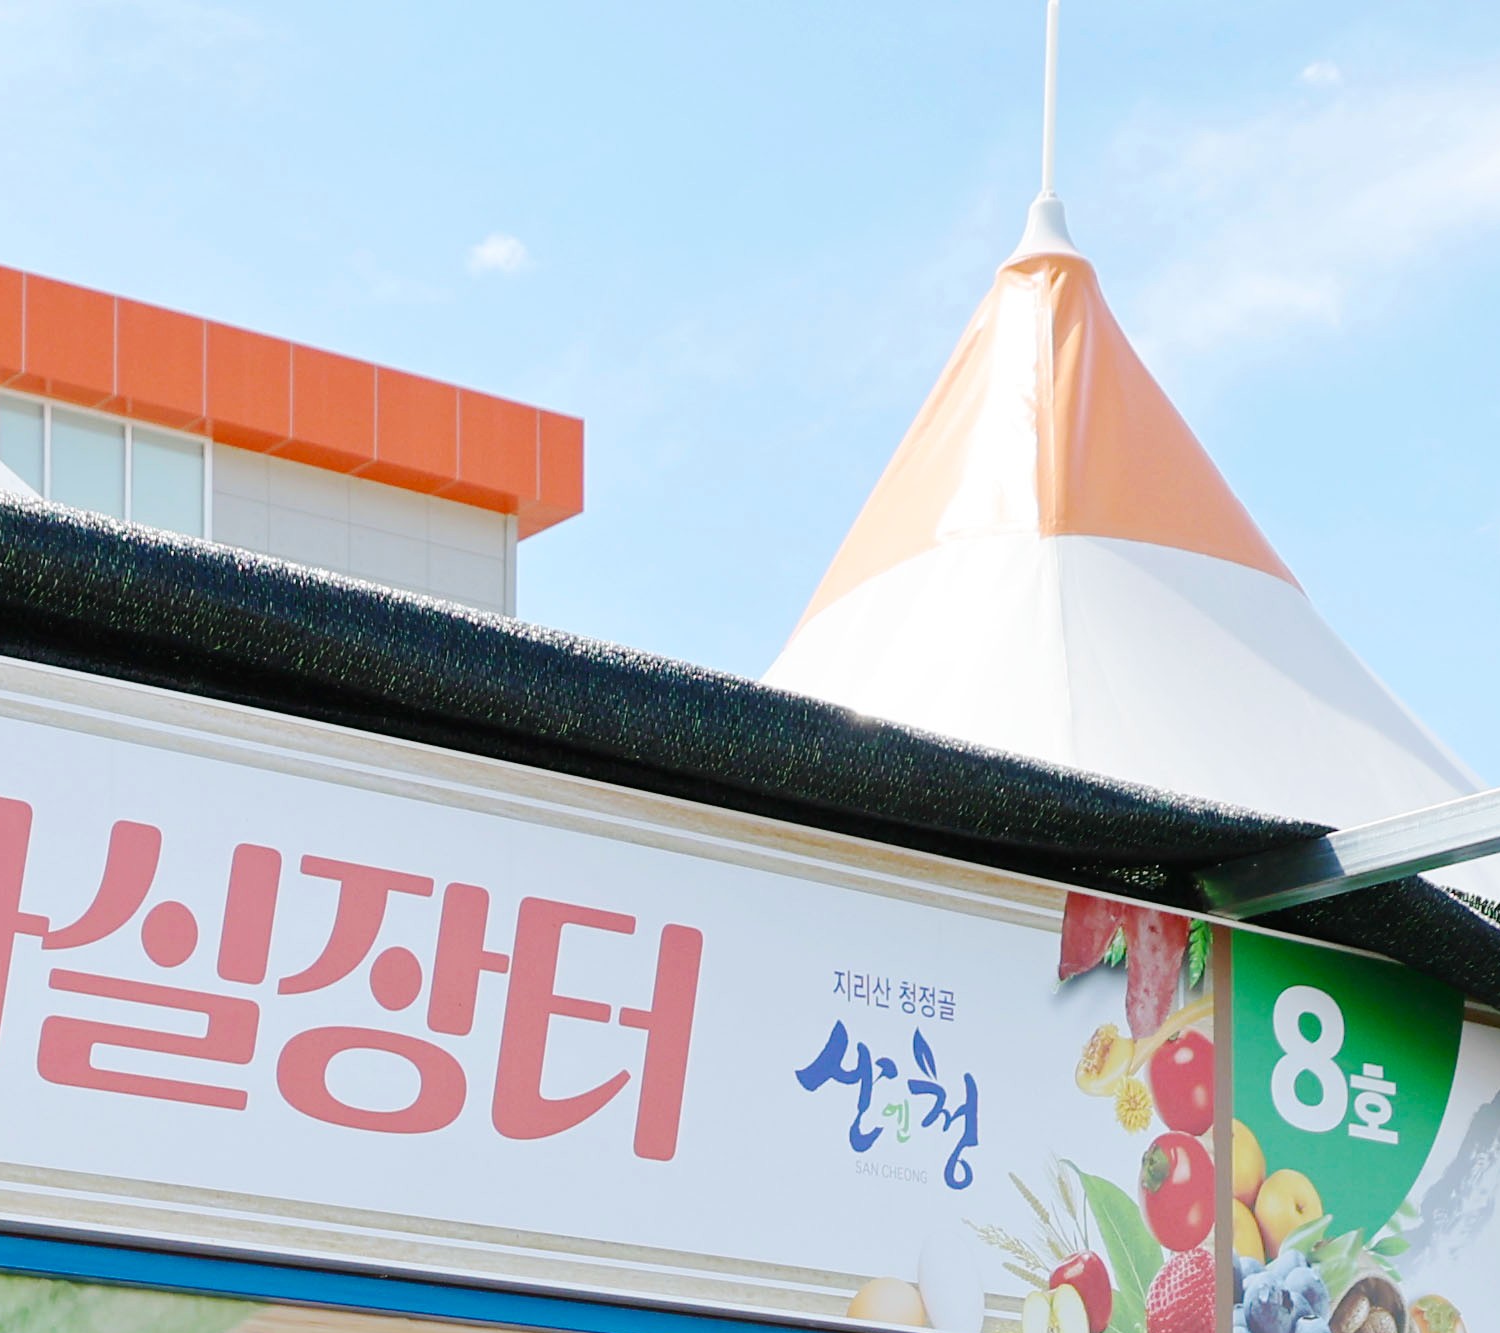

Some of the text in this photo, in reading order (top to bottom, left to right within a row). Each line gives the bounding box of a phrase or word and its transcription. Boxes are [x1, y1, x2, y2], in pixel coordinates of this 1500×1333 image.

[832, 968, 958, 1022] 지리산 청정골
[854, 1160, 929, 1186] SAN CHEONG
